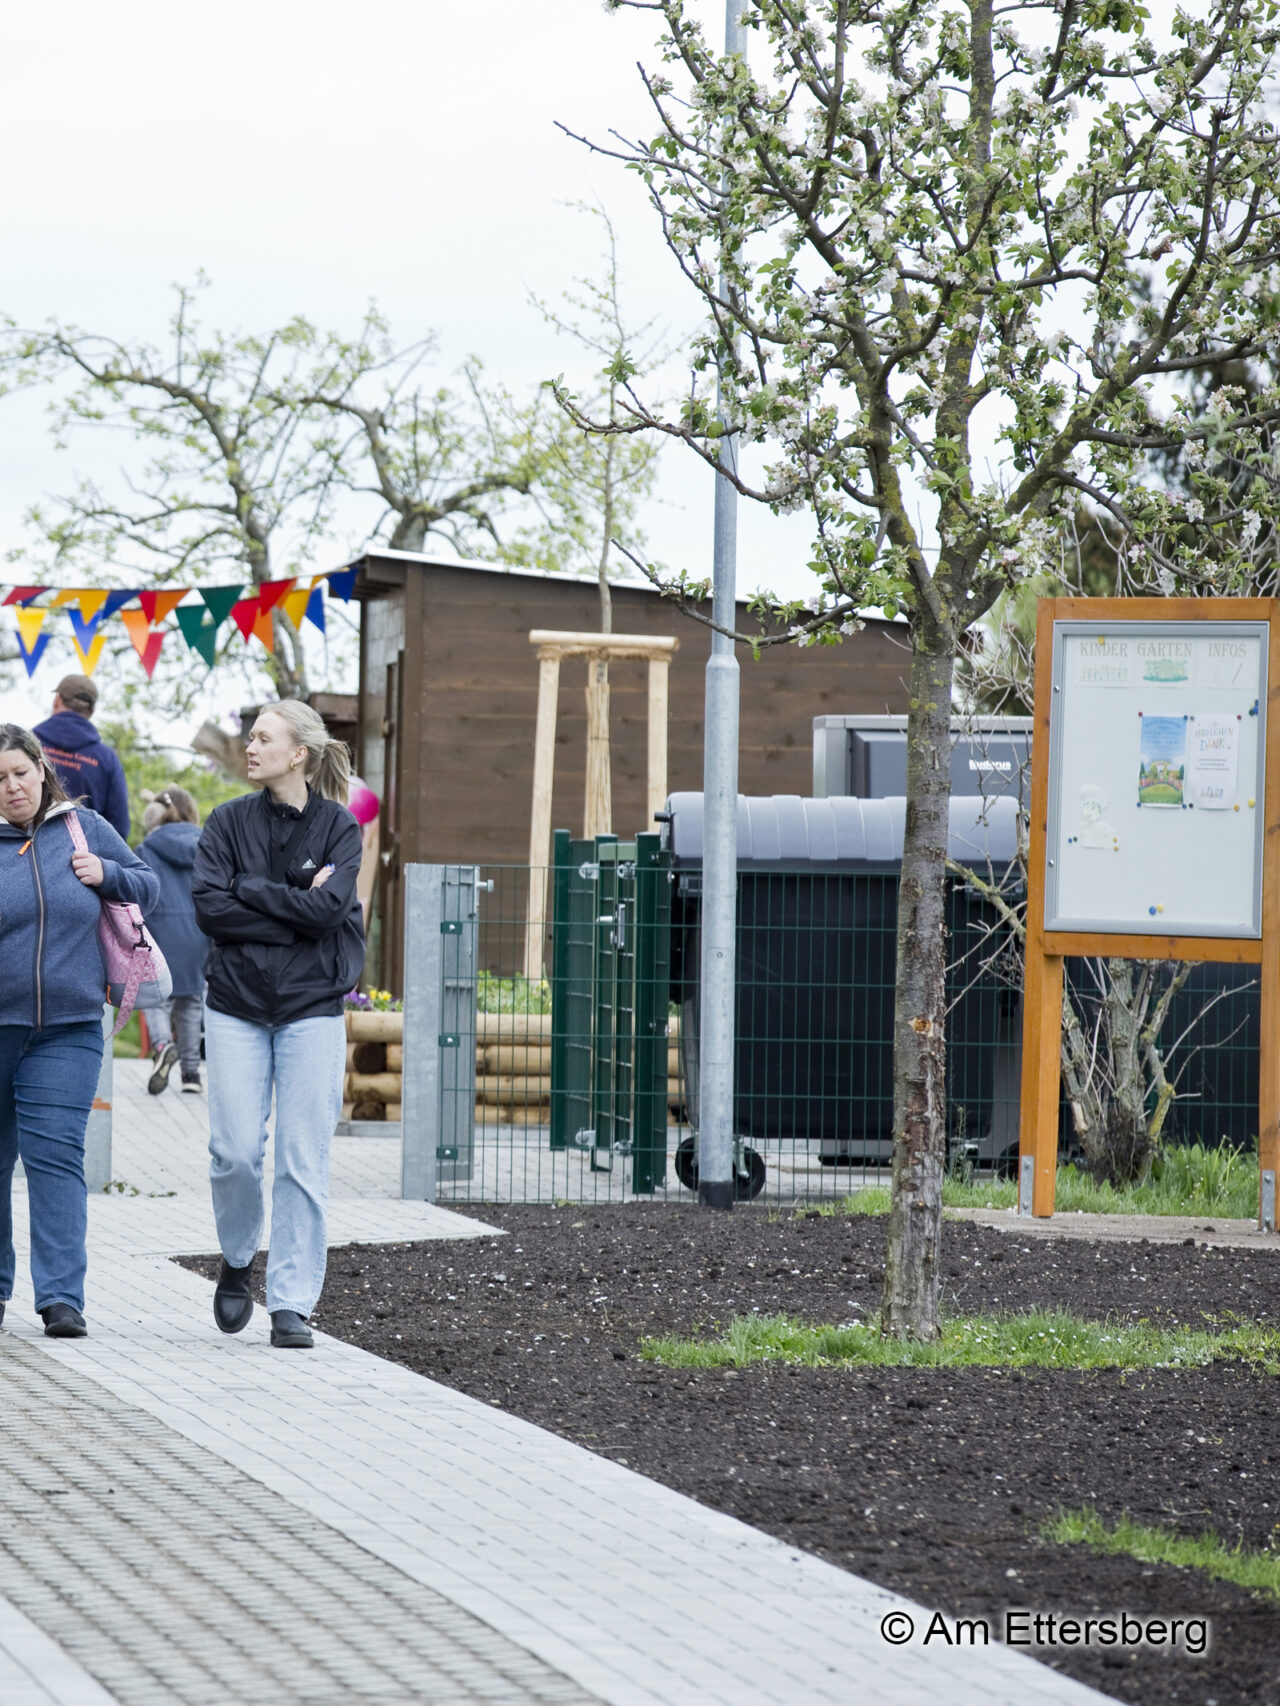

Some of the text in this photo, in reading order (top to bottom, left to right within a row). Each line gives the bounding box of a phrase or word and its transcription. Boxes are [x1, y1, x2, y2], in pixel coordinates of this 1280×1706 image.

[1080, 642, 1246, 657] KINDER GARTEN INFOS
